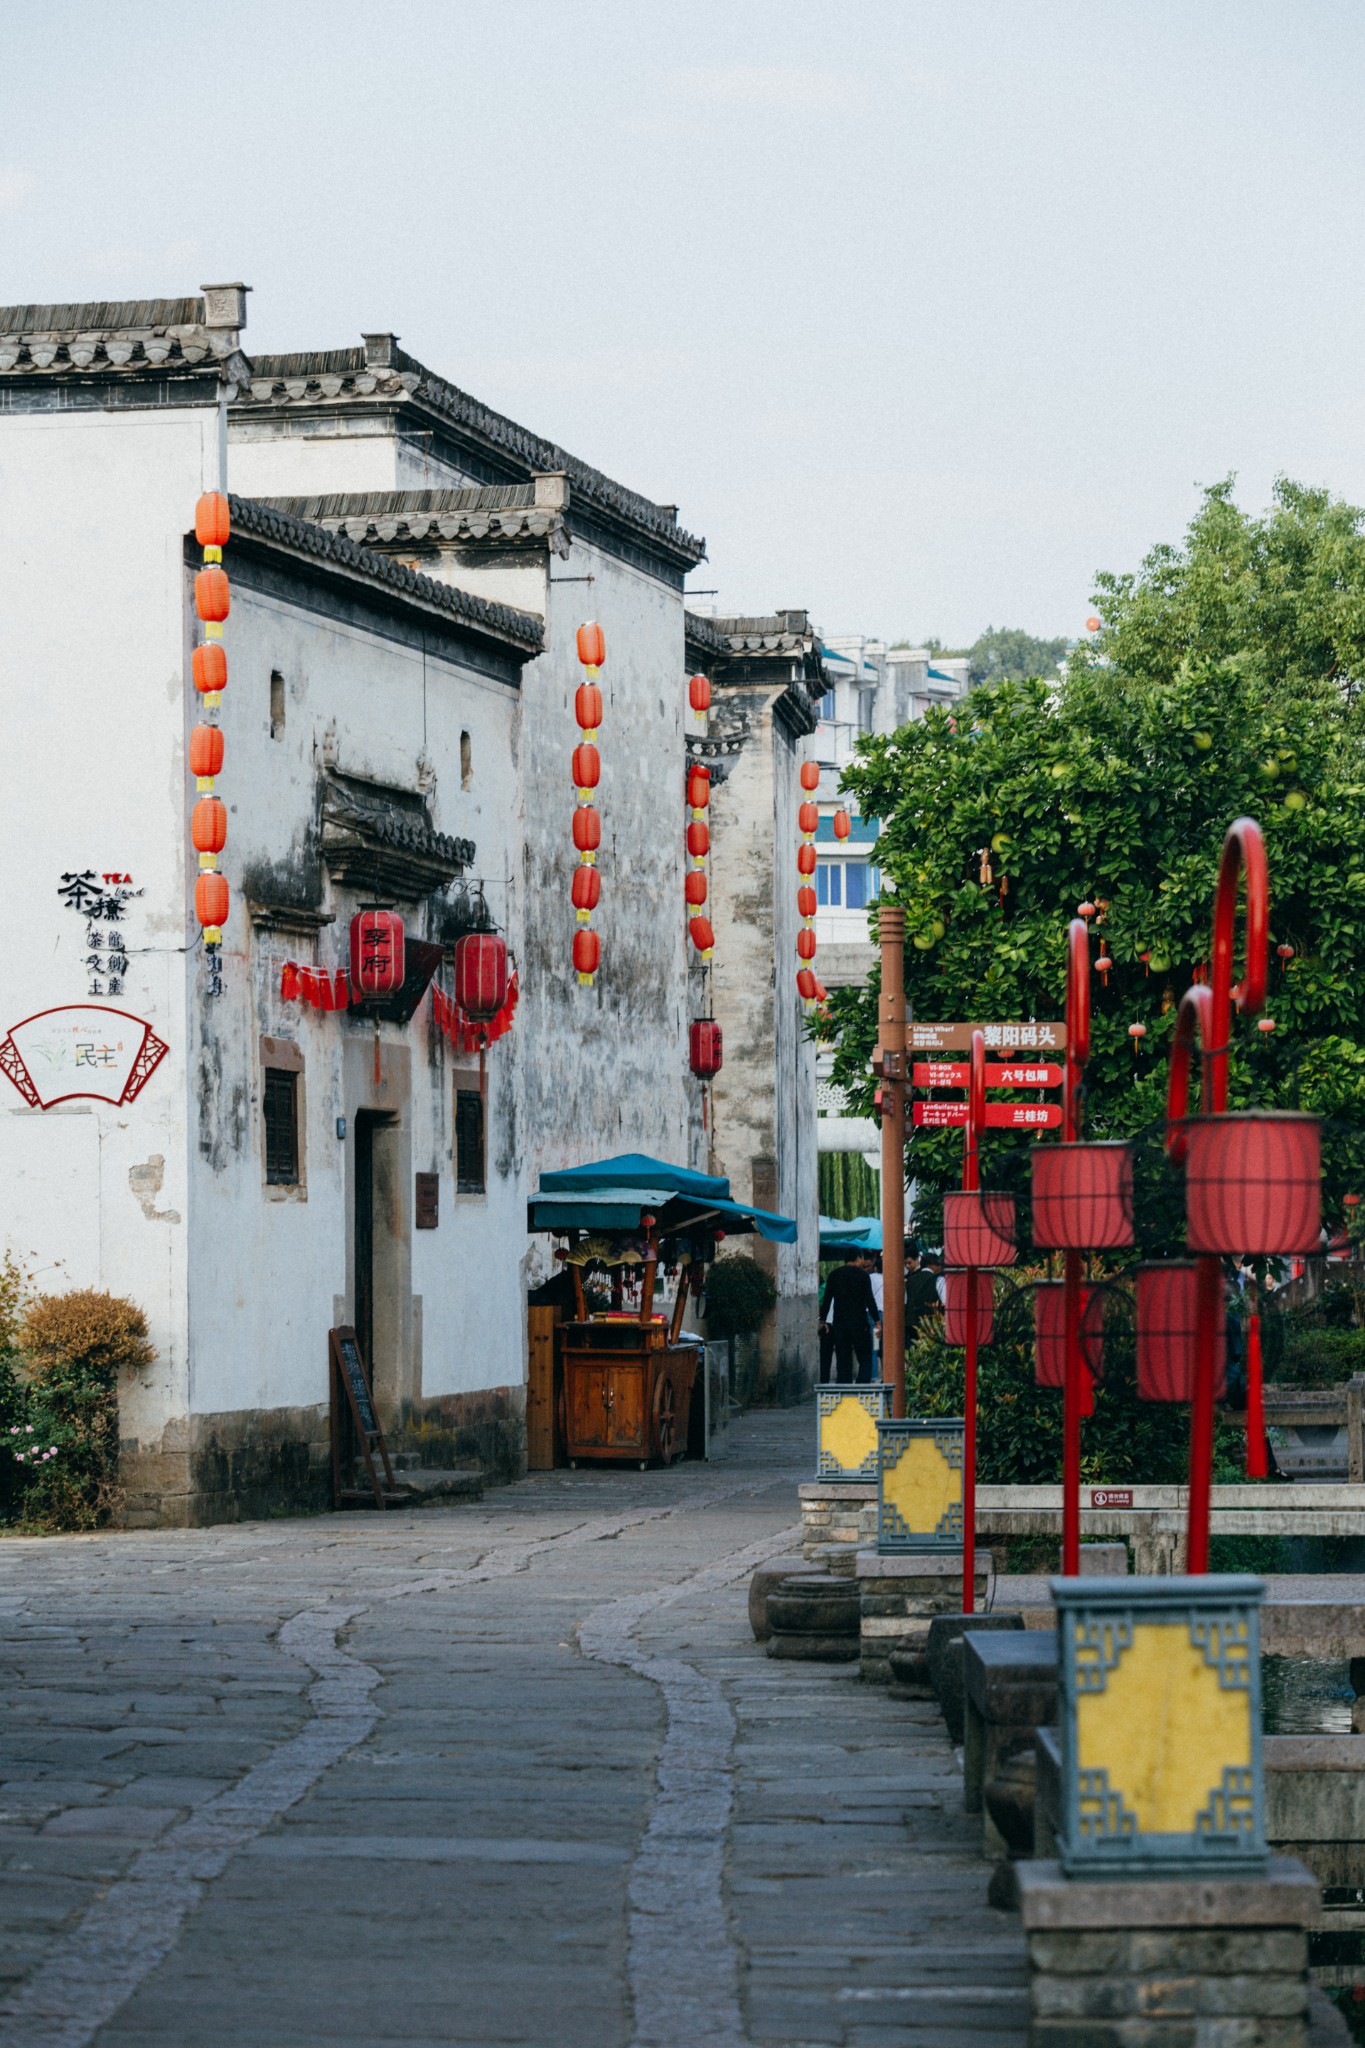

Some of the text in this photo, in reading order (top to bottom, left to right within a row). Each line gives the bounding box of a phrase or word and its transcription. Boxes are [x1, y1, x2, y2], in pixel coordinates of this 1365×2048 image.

[102, 872, 133, 885] TEA
[89, 930, 123, 948] 茶館
[984, 1025, 1056, 1046] 黎阳码头
[75, 1043, 118, 1068] 民主
[1001, 1069, 1048, 1082] 六号包厢
[1013, 1109, 1048, 1122] 兰桂坊
